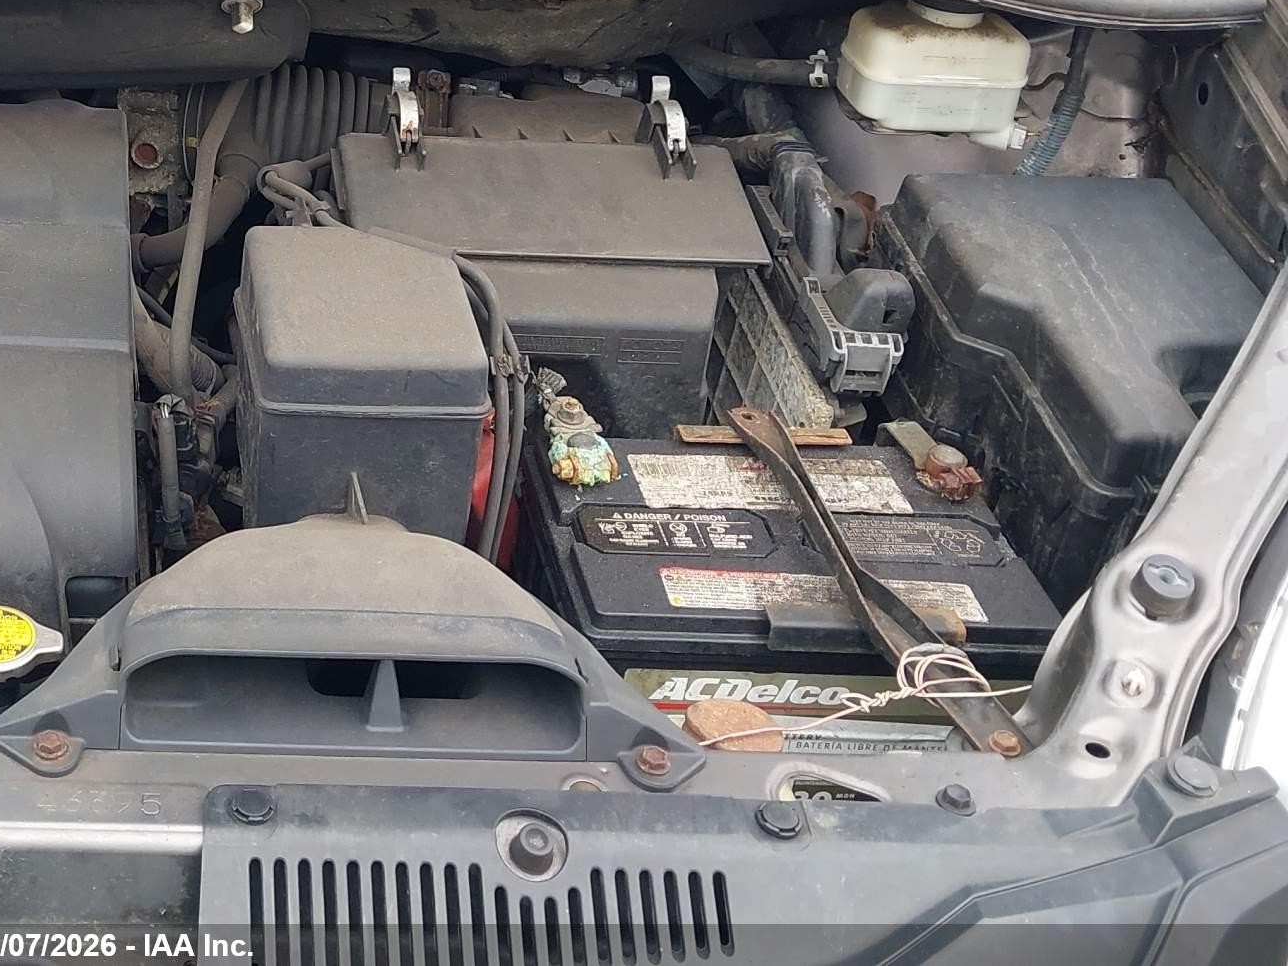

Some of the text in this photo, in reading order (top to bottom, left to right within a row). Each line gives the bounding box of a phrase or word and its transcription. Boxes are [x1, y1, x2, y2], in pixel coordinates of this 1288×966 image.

[623, 512, 673, 520] DANGER
[684, 514, 726, 522] POISON
[648, 677, 850, 705] ACDelco
[847, 742, 879, 752] LIBRE
